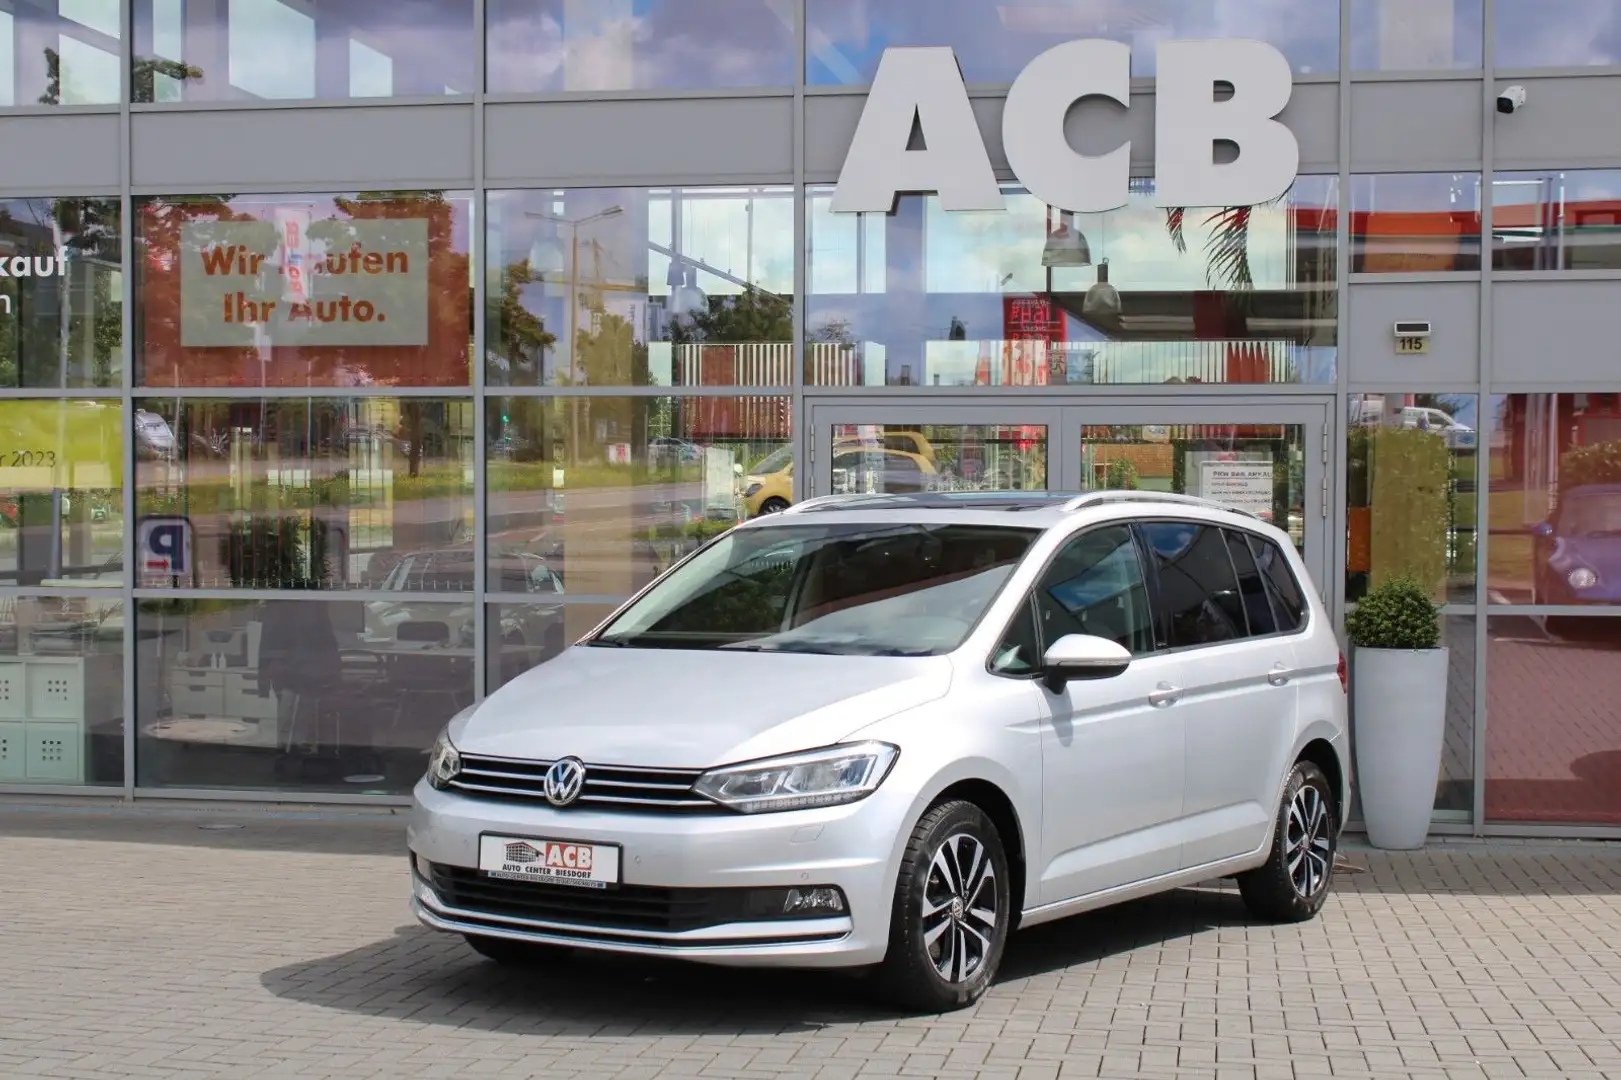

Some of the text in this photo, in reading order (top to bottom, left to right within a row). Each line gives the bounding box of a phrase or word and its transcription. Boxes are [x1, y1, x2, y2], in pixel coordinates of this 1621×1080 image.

[829, 38, 1298, 213] ACB
[201, 245, 265, 275] Wir
[224, 291, 386, 323] Ihr Auto.
[1400, 336, 1423, 350] 115
[11, 450, 56, 468] 2023
[546, 843, 593, 869] ACB
[502, 863, 592, 879] AUTO CENTER BIESDORF
